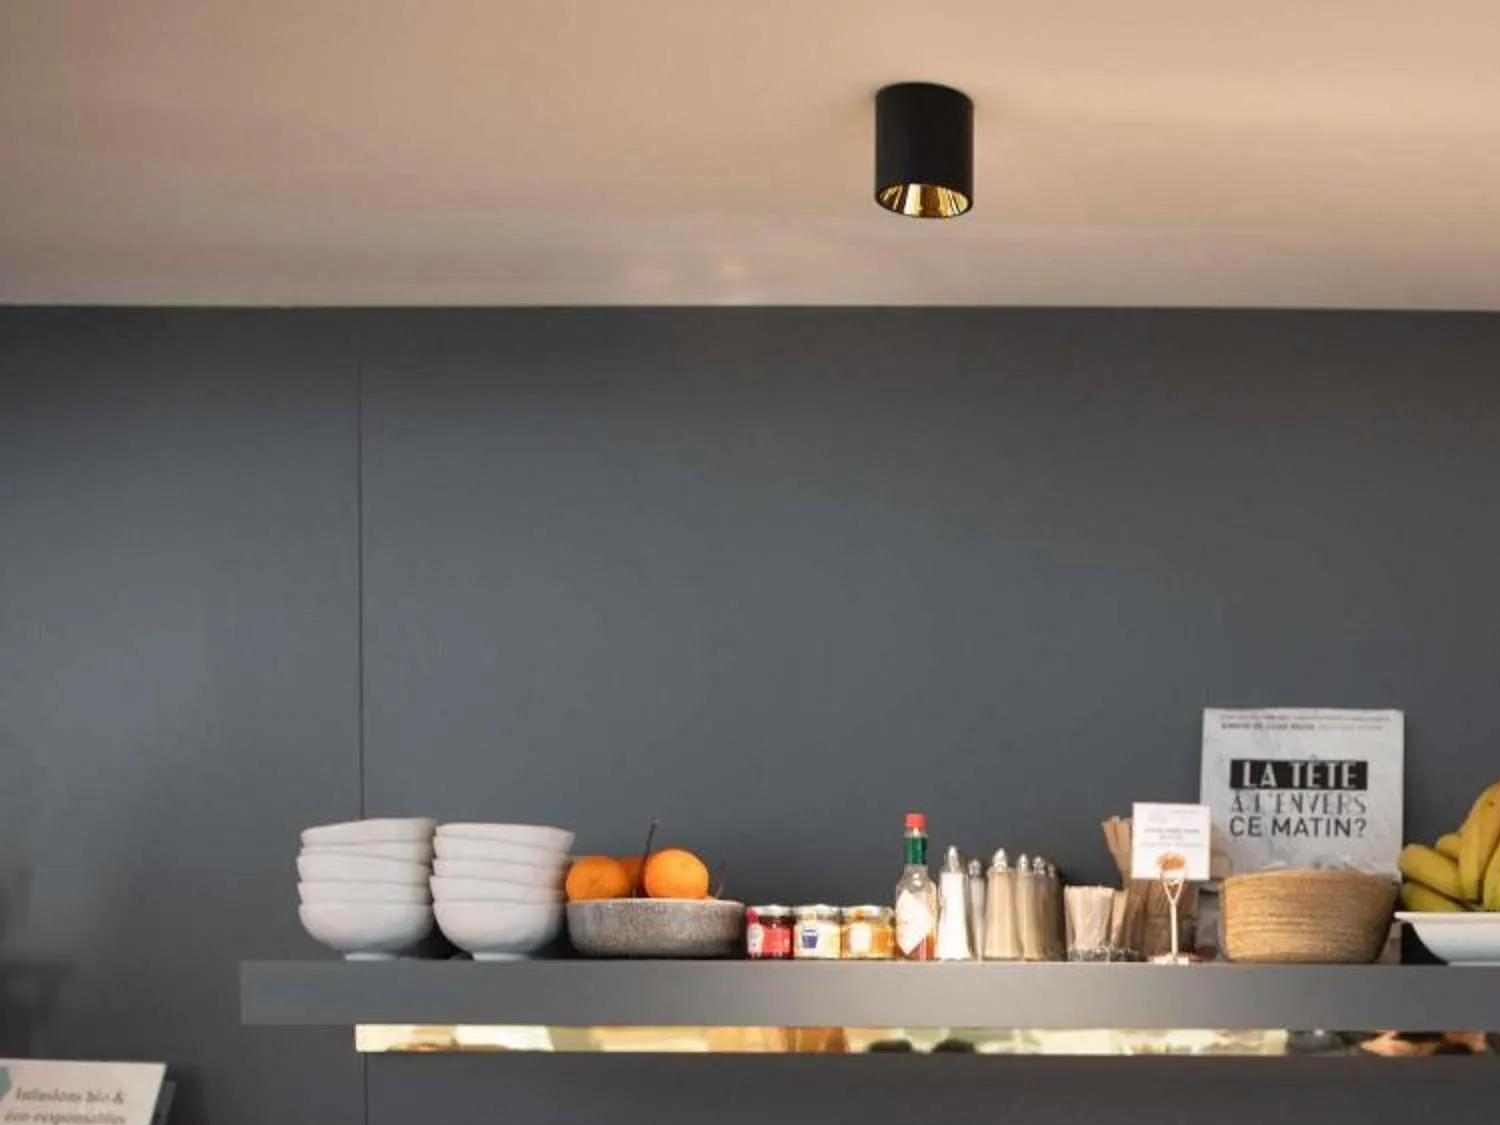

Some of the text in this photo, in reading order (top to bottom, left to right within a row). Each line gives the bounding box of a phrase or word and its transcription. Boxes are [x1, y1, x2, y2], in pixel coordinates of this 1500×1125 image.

[1242, 760, 1278, 788] LA
[1229, 816, 1368, 838] CE MATIN?
